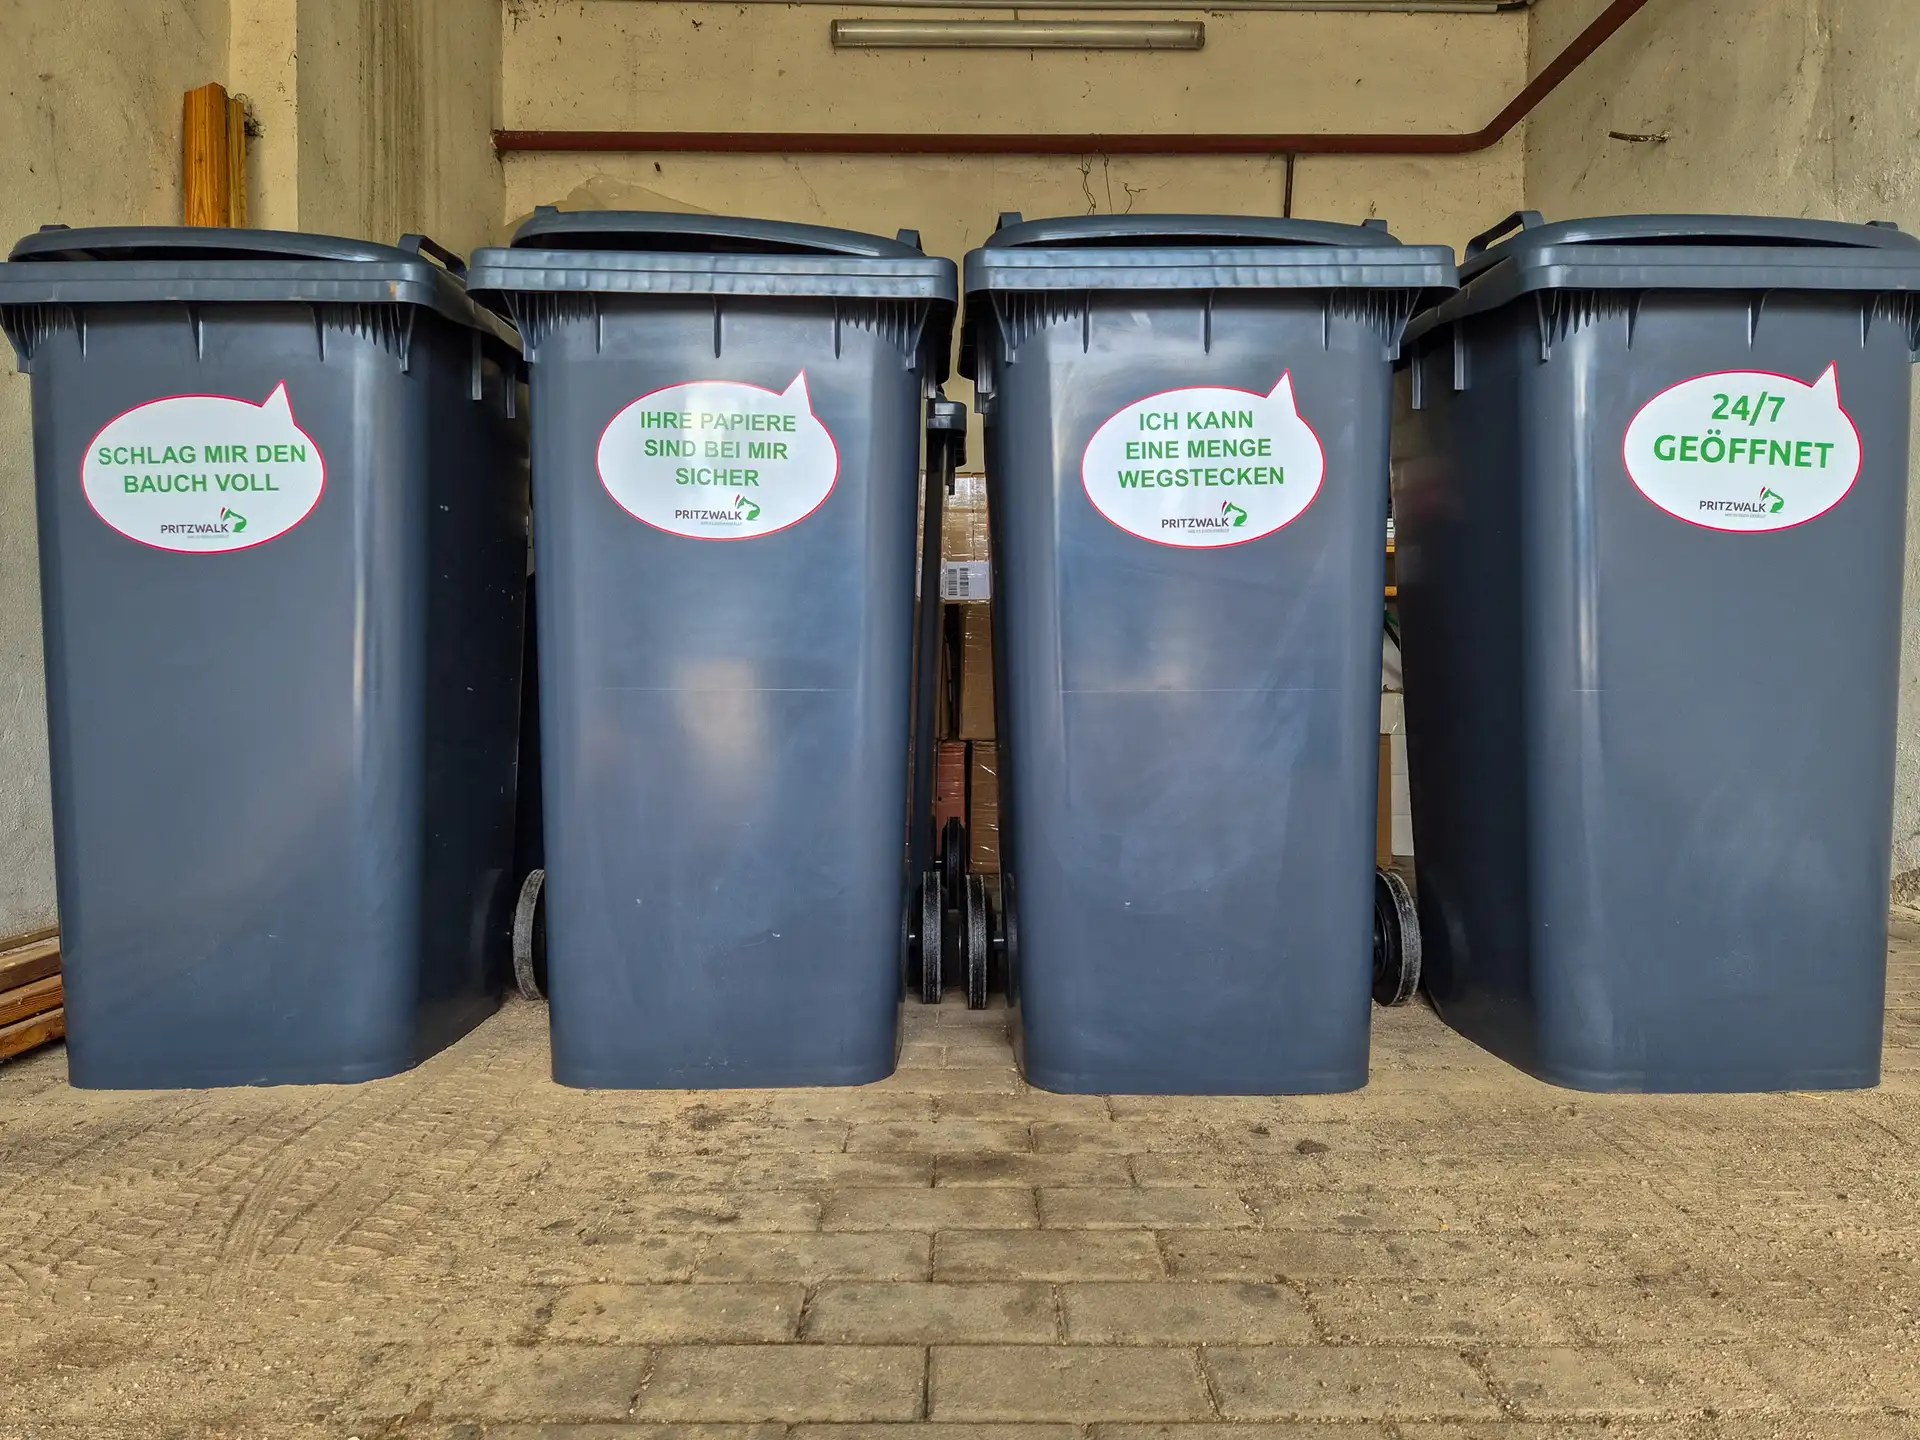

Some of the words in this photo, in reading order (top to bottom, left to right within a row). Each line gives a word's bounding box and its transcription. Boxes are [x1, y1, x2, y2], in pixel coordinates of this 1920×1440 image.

[1711, 391, 1785, 426] 24/7
[640, 411, 692, 429] IHRE
[701, 413, 796, 432] PAPIERE
[1140, 411, 1179, 431] ICH
[1187, 410, 1253, 430] KANN
[98, 446, 196, 466] SCHLAG
[204, 445, 248, 463] MIR
[256, 444, 306, 463] DEN
[644, 439, 696, 457] SIND
[704, 440, 740, 458] BEI
[748, 442, 788, 460] MIR
[1125, 440, 1179, 460] EINE
[1187, 438, 1272, 458] MENGE
[1653, 429, 1834, 469] GEÖFFNET
[124, 474, 207, 493] BAUCH
[215, 473, 279, 492] VOLL
[675, 468, 759, 487] SICHER
[1118, 466, 1284, 489] WEGSTECKEN
[675, 509, 742, 521] PRITZWALK
[1699, 500, 1766, 513] PRITZWALK
[161, 523, 229, 534] PRITZWALK
[1161, 517, 1229, 529] PRITZWALK
